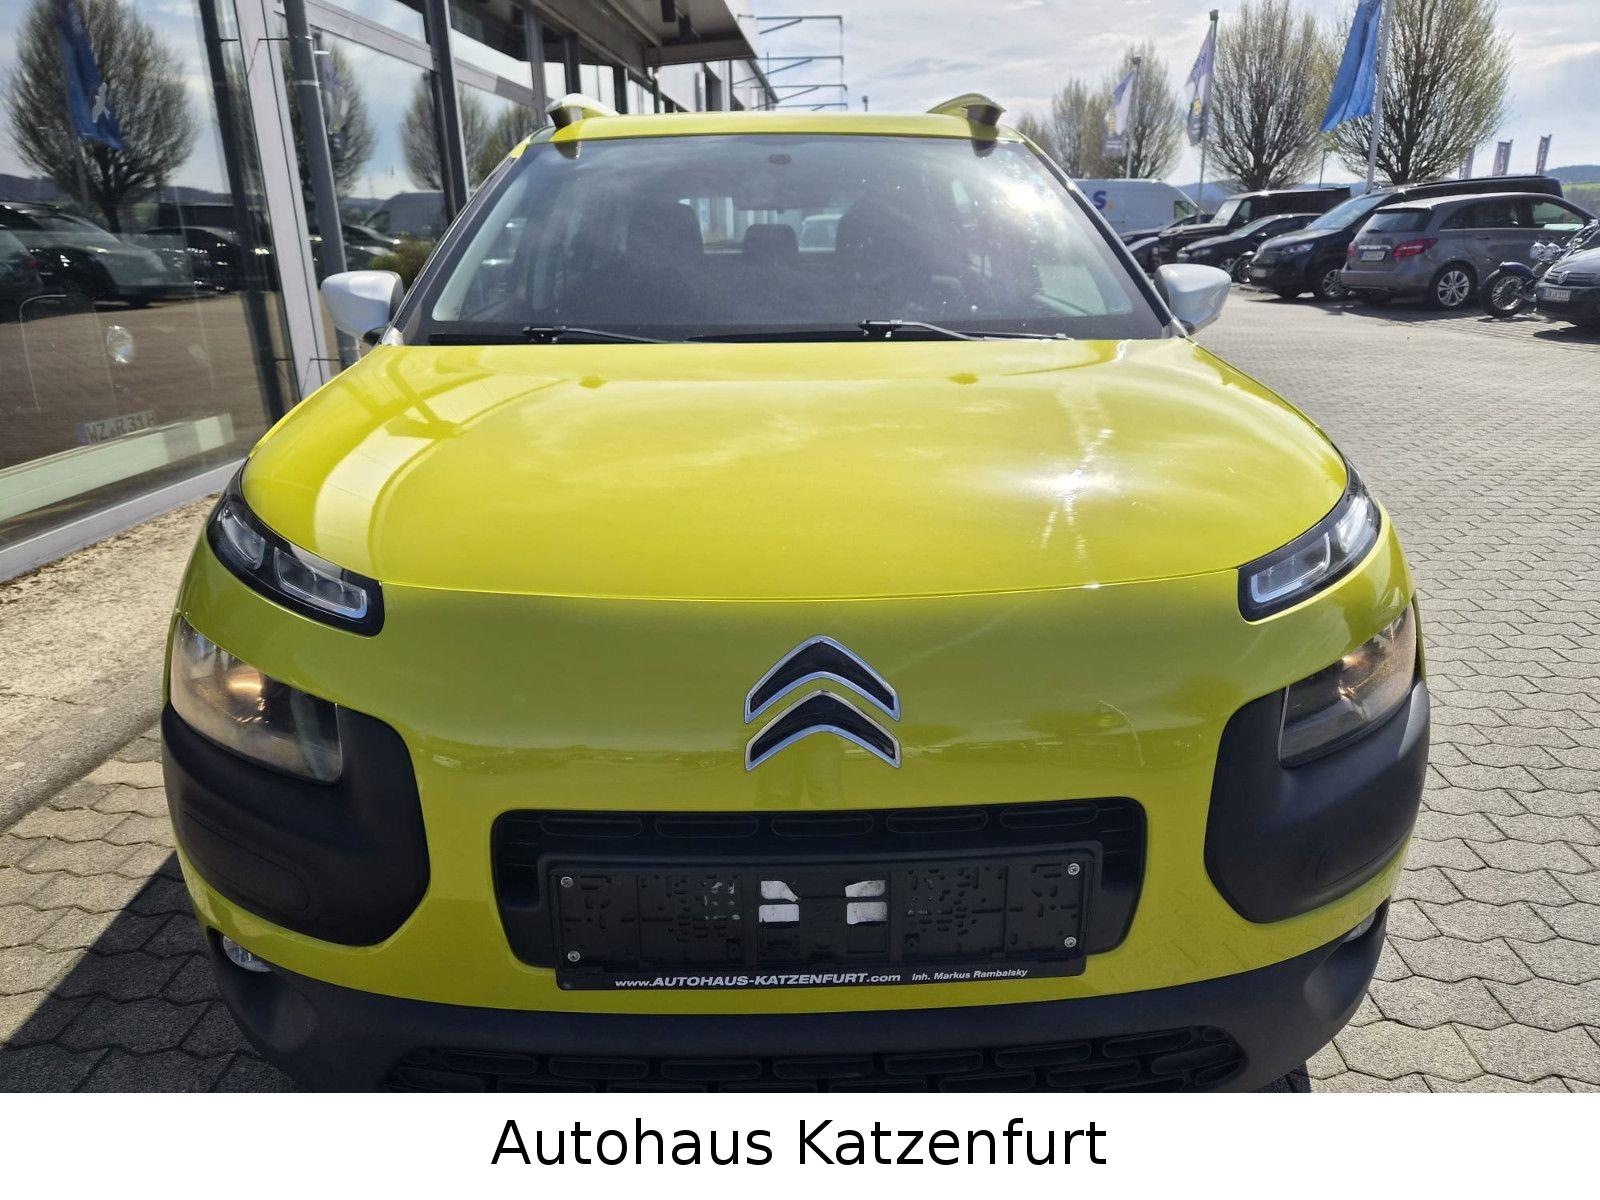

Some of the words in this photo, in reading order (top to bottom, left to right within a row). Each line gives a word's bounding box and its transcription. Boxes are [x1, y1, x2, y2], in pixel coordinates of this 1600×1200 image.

[614, 972, 901, 987] www.AUTOHAUS-KATZENFURT.com
[911, 973, 931, 981] Inh.
[934, 971, 970, 980] Markus
